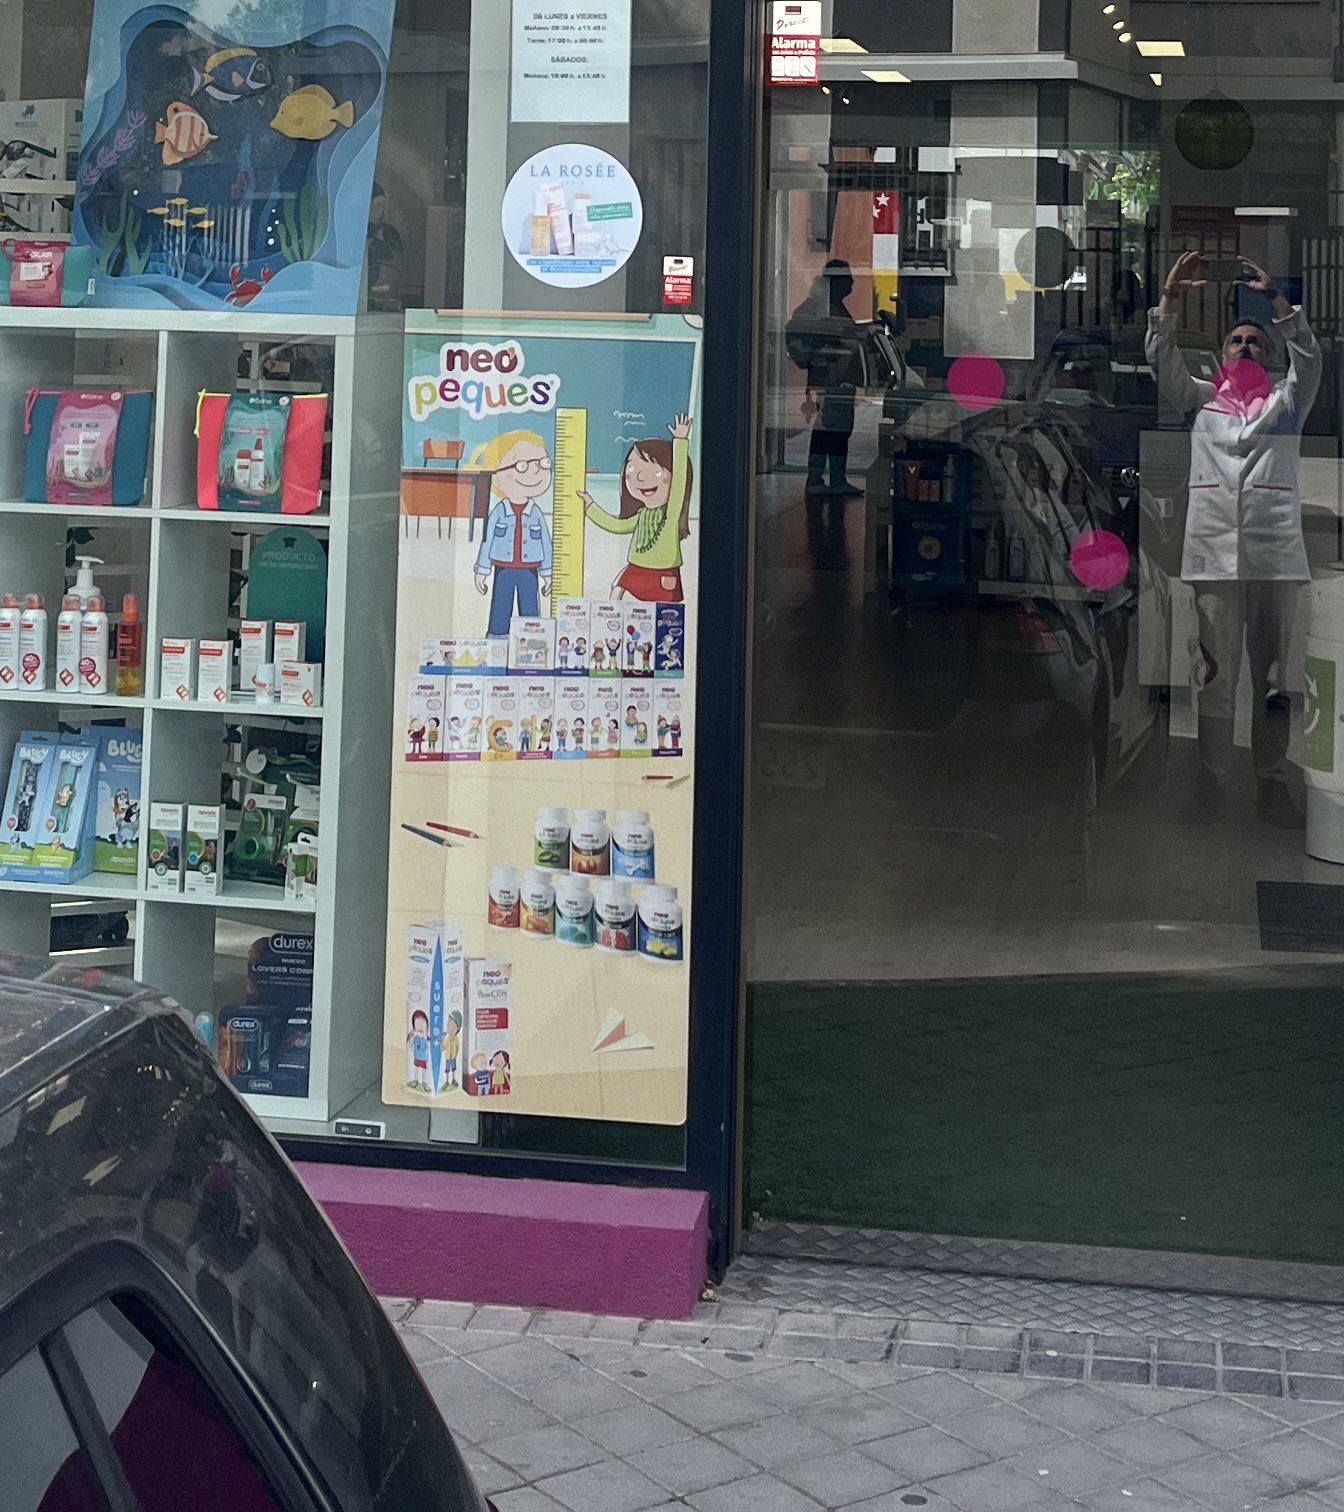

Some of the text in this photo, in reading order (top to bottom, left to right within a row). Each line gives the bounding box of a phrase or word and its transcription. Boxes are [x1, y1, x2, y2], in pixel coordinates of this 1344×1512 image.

[771, 36, 816, 49] Alarma
[530, 161, 616, 178] LA ROSÉE
[446, 346, 518, 374] neo
[414, 378, 551, 416] peques
[261, 551, 316, 563] PRODUCTO
[273, 935, 313, 950] durex
[483, 970, 502, 978] neo
[232, 1018, 256, 1029] durex
